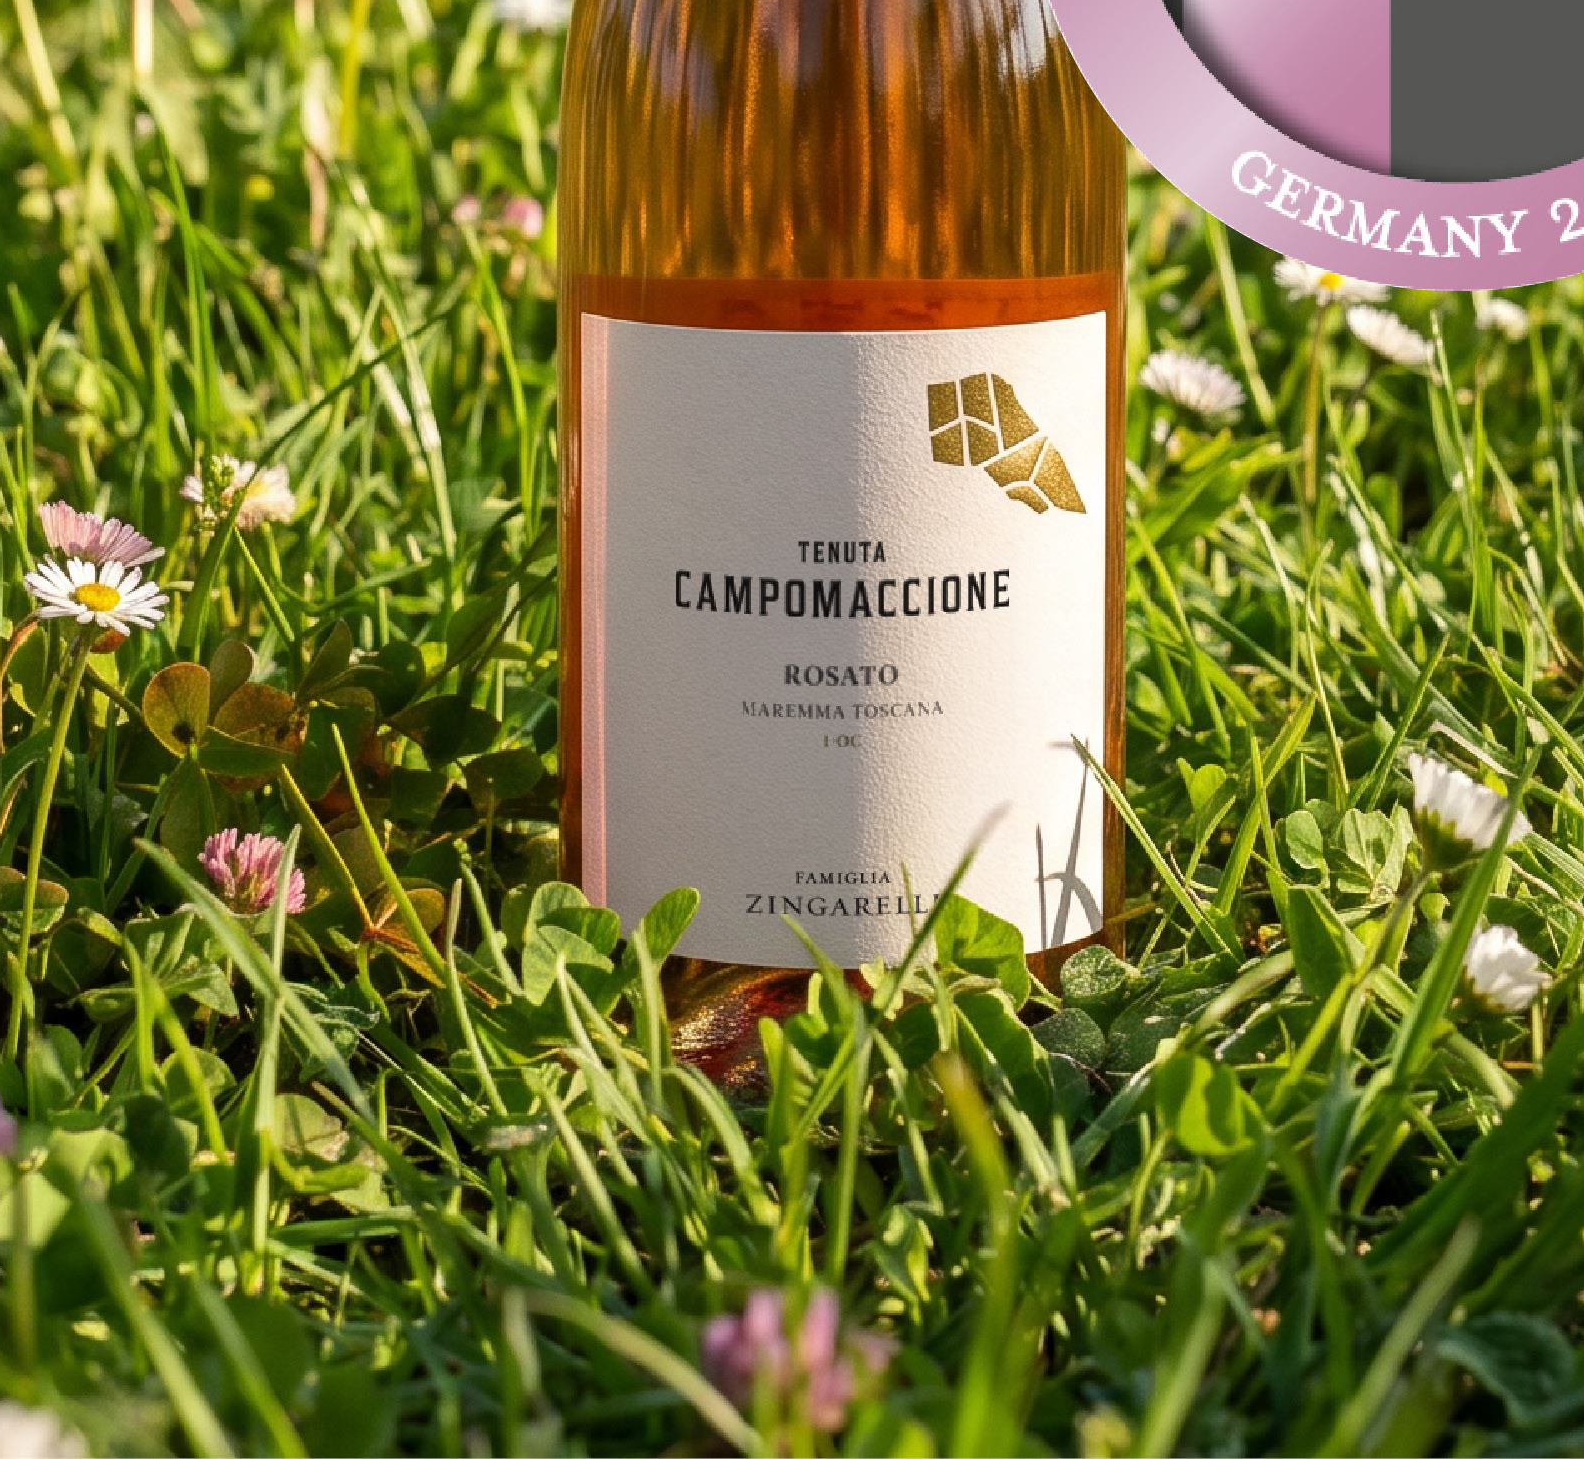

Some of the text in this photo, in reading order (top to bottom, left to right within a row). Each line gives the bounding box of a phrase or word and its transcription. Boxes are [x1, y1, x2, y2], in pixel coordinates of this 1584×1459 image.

[798, 541, 887, 564] TENUTA
[675, 569, 1010, 618] CAMPOMACCIONE
[784, 664, 899, 686] ROSATO
[742, 700, 944, 719] MAREMMA TOSCANA
[795, 871, 891, 884] FAMIGLIA
